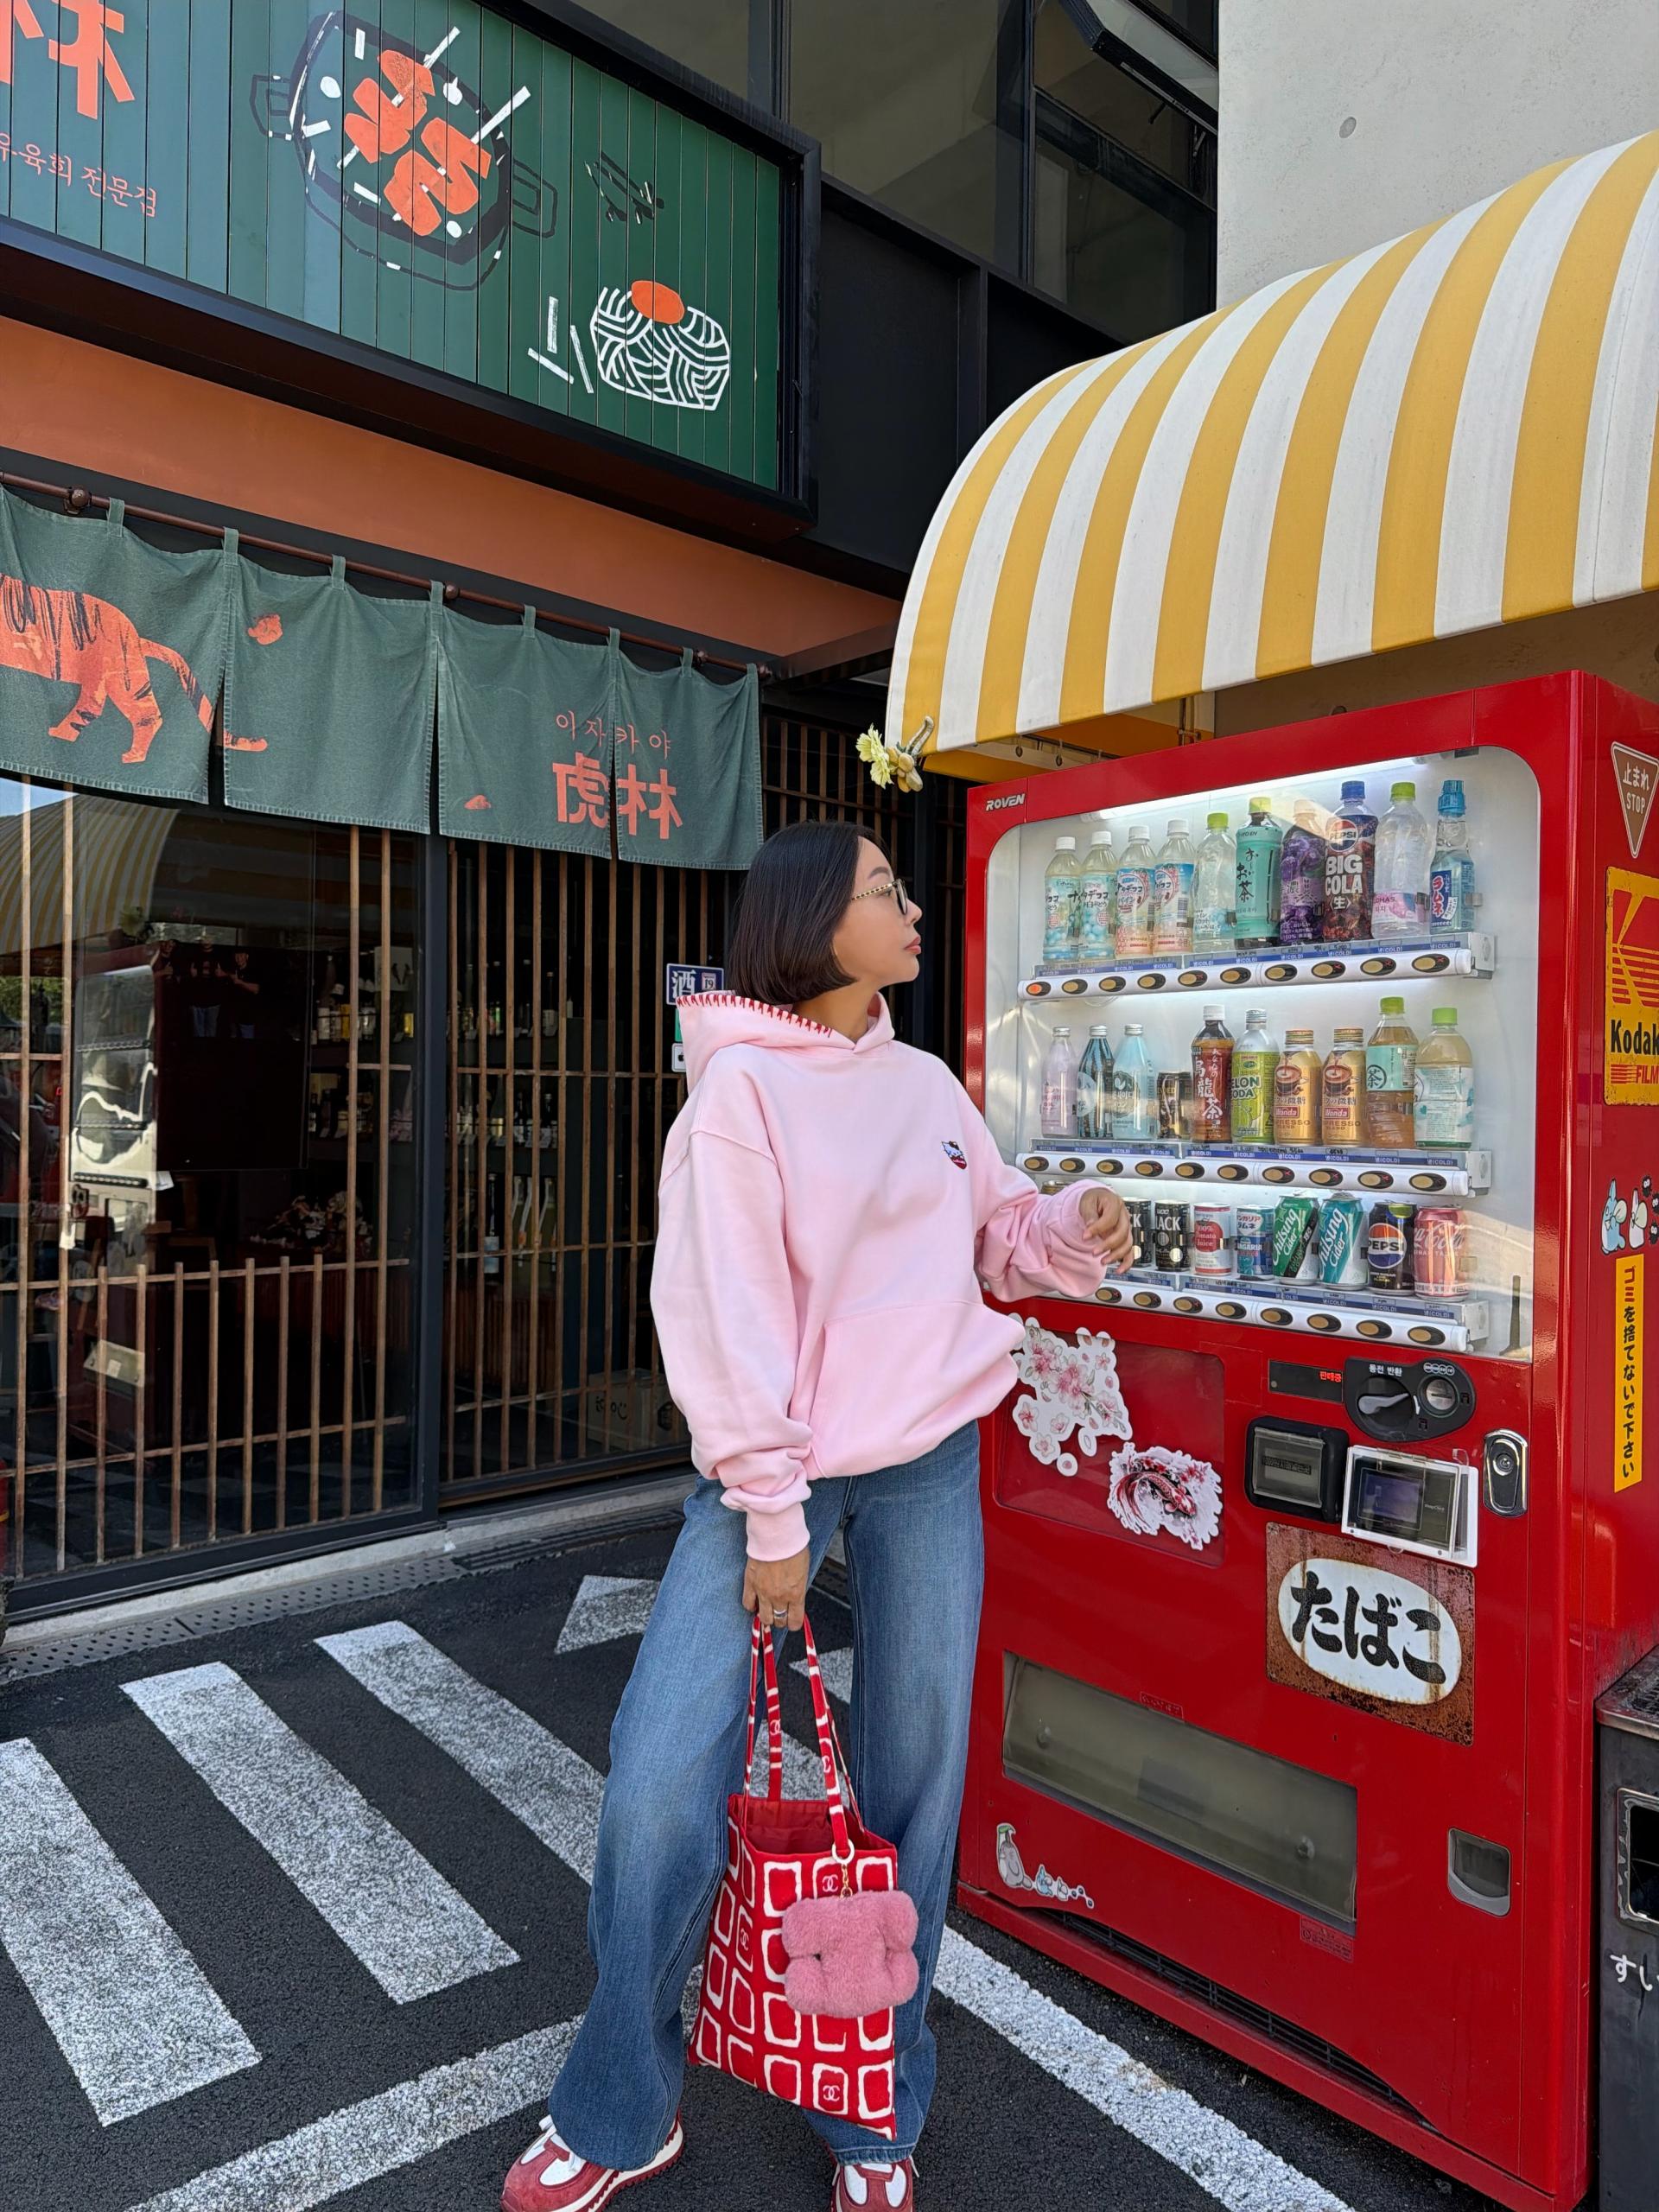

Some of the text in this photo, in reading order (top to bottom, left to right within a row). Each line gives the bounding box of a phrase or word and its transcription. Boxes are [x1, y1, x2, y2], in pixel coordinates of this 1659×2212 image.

[81, 167, 157, 218] 전문점
[556, 710, 671, 760] 이자카야
[1623, 762, 1649, 791] 止まれ
[986, 793, 1026, 811] ROVEN
[1626, 792, 1646, 815] STOP
[1330, 831, 1357, 841] PEPSI
[1325, 854, 1363, 876] BIG
[1325, 874, 1363, 896] COLA
[1432, 875, 1444, 918] ラムネ
[1611, 1020, 1659, 1055] Kodak
[1231, 1076, 1261, 1089] ELON
[1367, 1068, 1382, 1089] 茶
[1636, 1065, 1659, 1084] FILM
[1283, 1228, 1298, 1255] Cider
[1330, 1231, 1345, 1267] Cider
[1319, 1370, 1342, 1382] 판매중
[1369, 1363, 1403, 1376] 동전 반환
[1623, 1264, 1636, 1478] ゴミを捨てないで下さい
[1290, 1571, 1446, 1685] たばこ
[1610, 1954, 1659, 1992] すし
